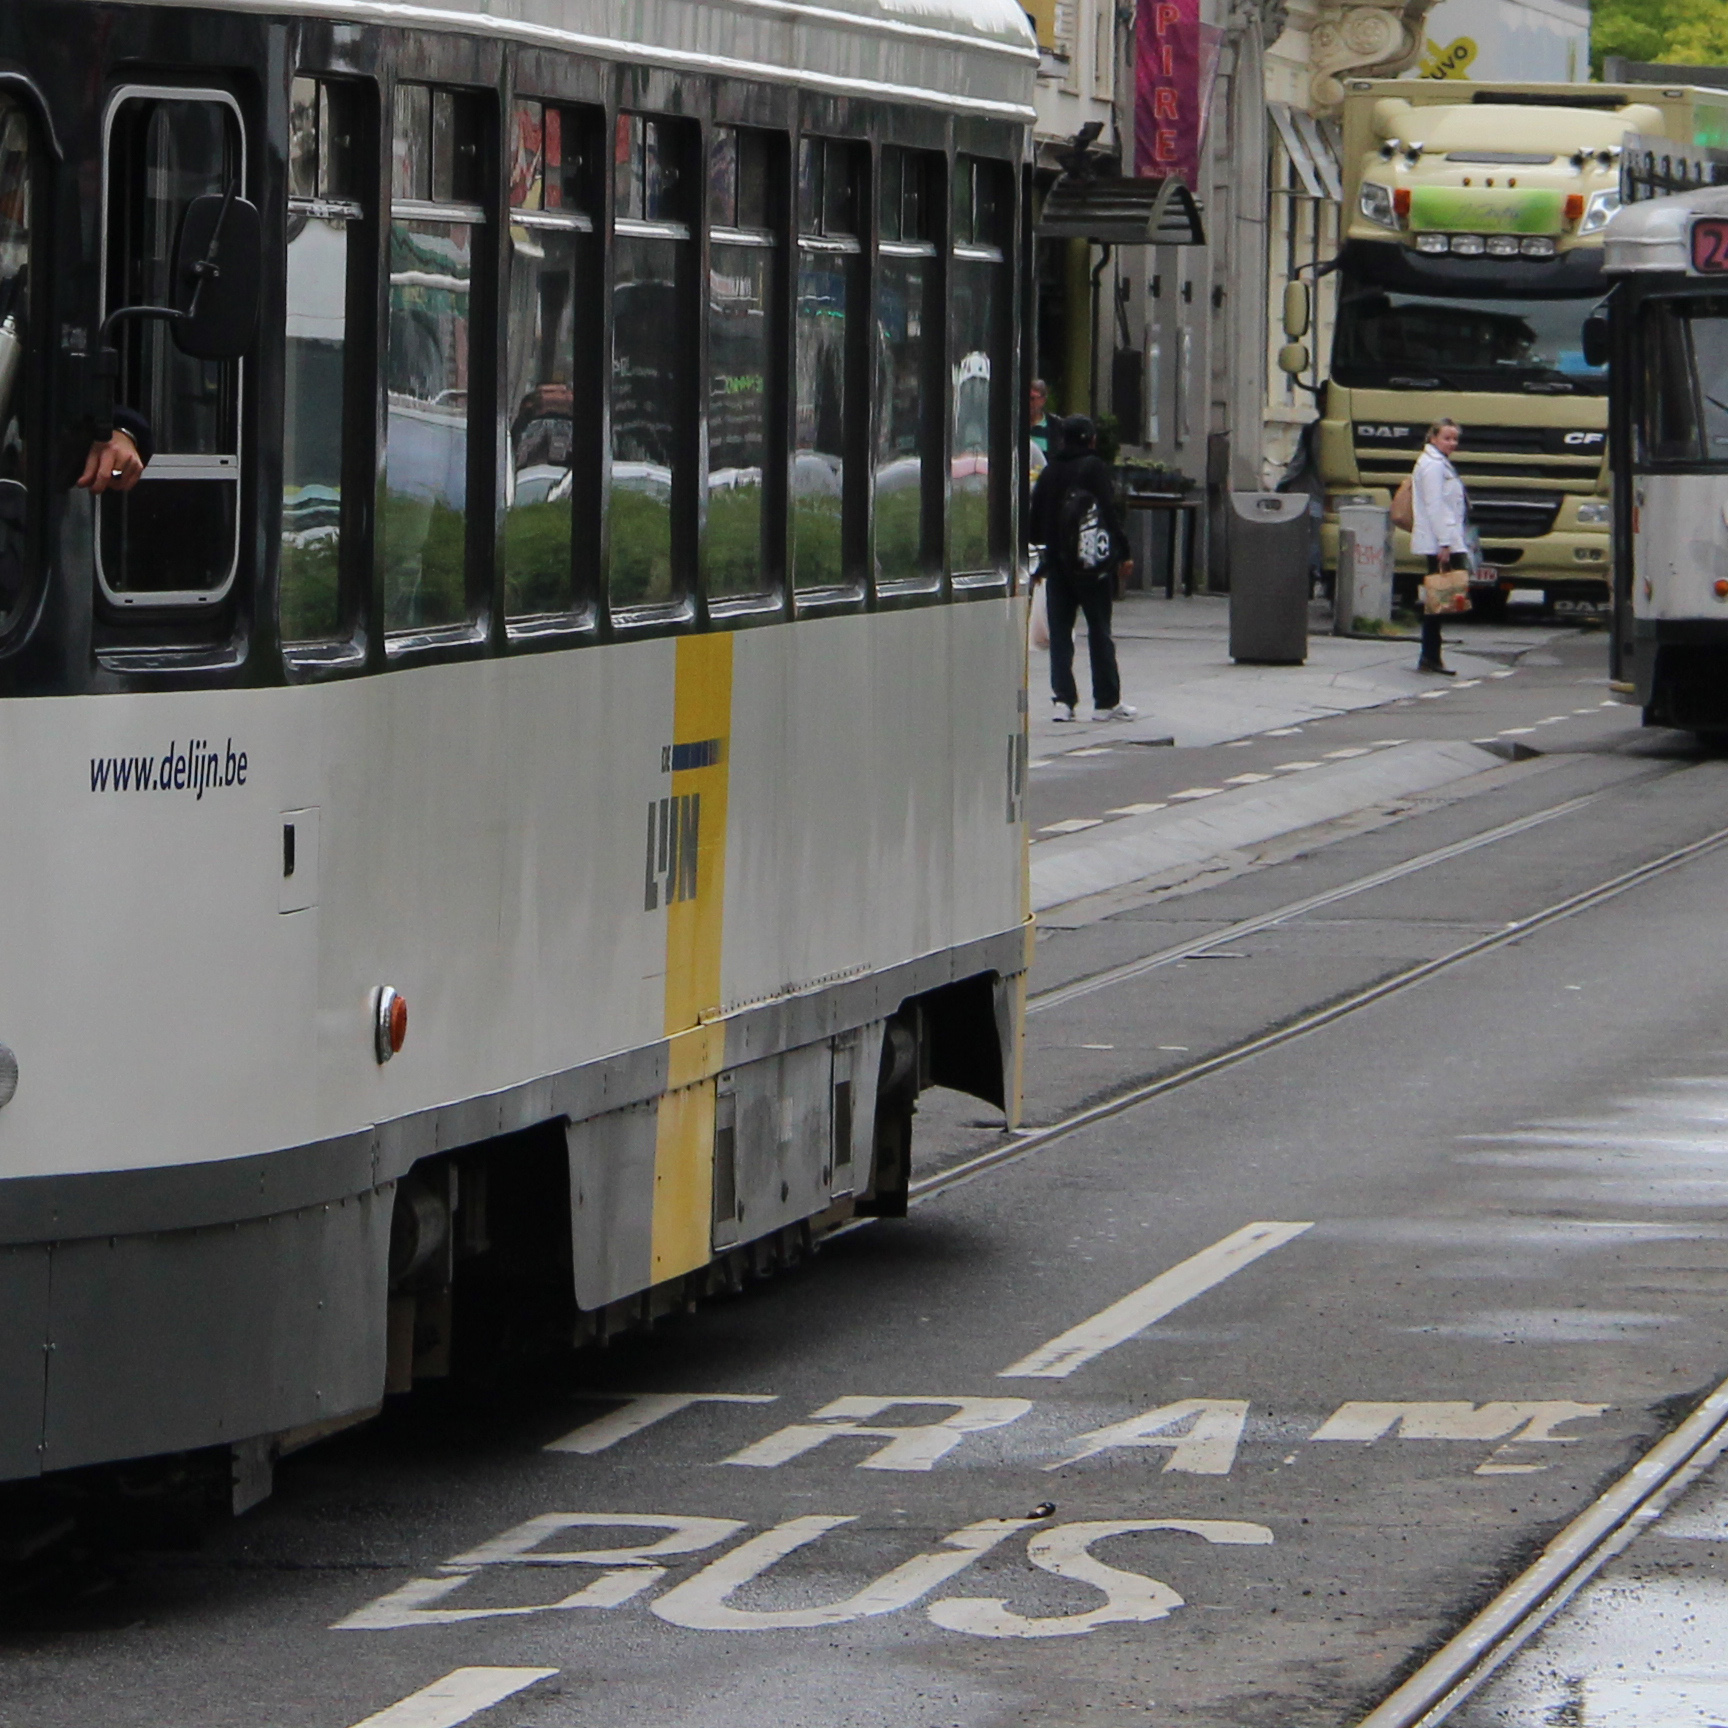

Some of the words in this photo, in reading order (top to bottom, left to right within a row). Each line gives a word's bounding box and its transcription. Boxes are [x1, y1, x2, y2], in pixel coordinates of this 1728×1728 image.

[1357, 426, 1410, 438] DAF
[1564, 432, 1604, 445] CF
[91, 737, 248, 801] www.delijn.be
[542, 1392, 1612, 1474] TRAM
[330, 1512, 1274, 1640] BUS
